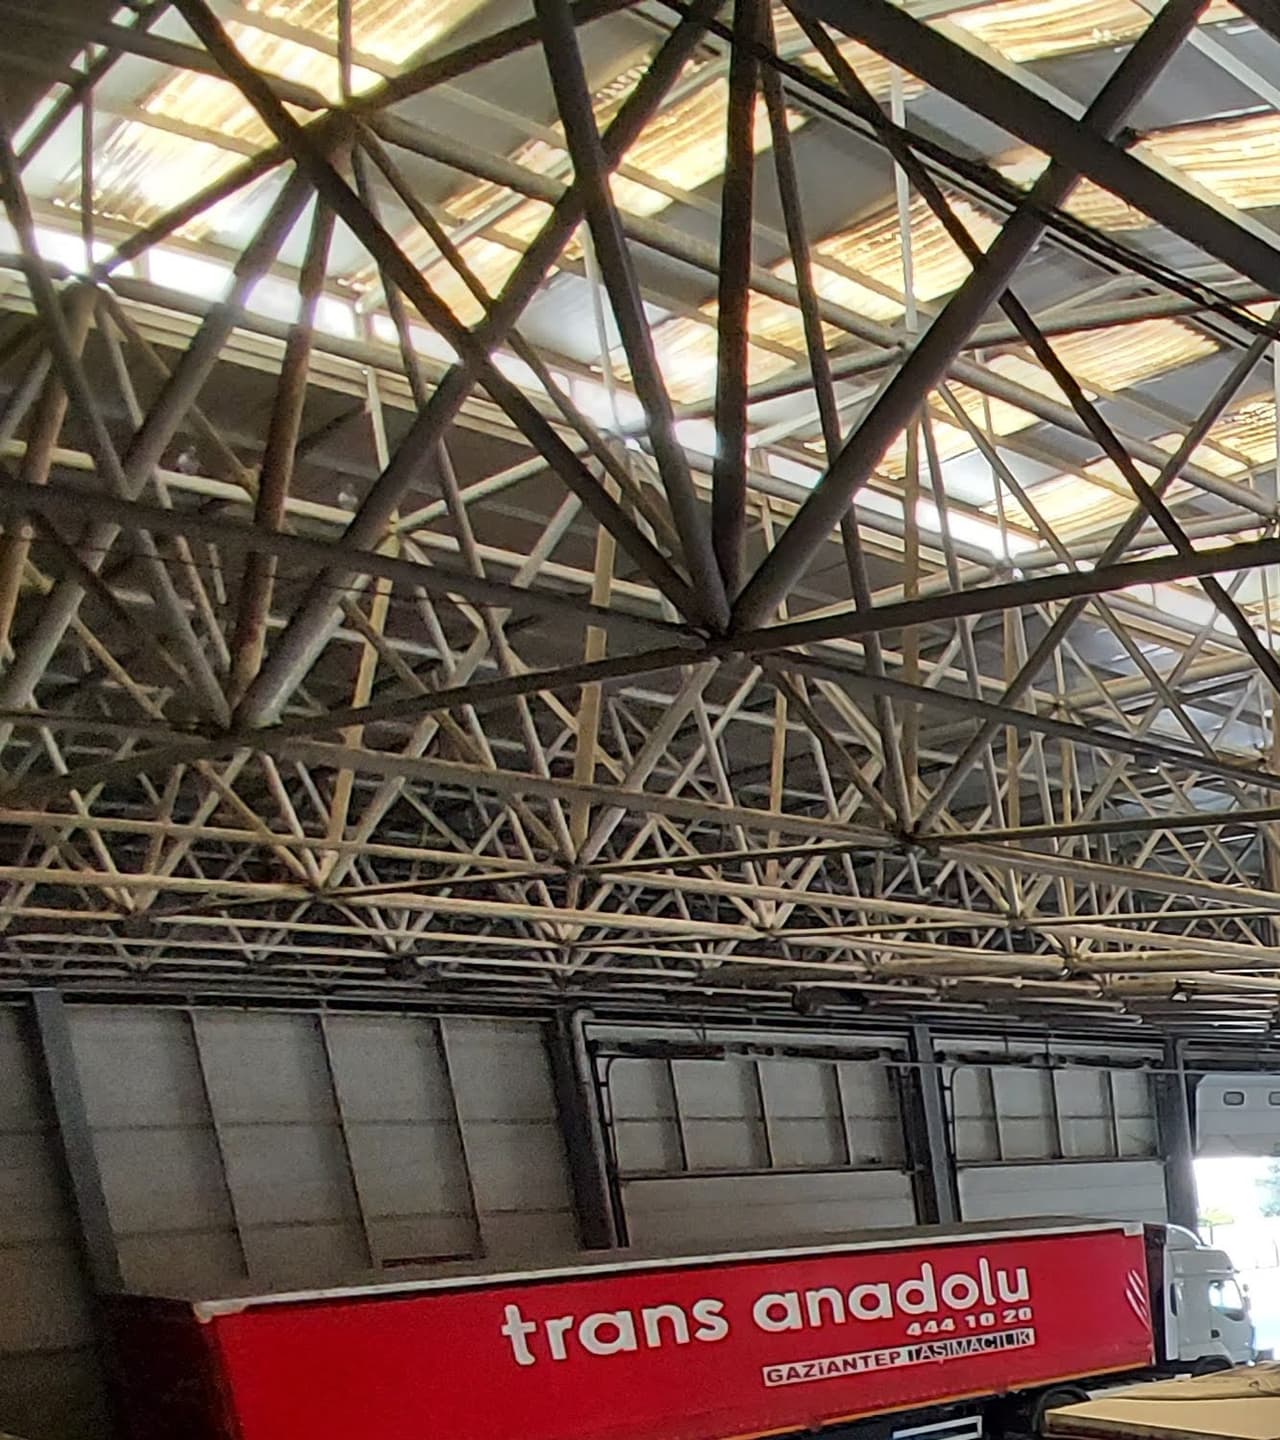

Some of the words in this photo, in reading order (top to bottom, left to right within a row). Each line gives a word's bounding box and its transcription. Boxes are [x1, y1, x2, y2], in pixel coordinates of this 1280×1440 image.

[502, 1299, 729, 1366] trans
[753, 1257, 1030, 1332] anadolu
[906, 1318, 956, 1336] 444
[965, 1311, 995, 1328] 10
[1002, 1306, 1033, 1324] 20
